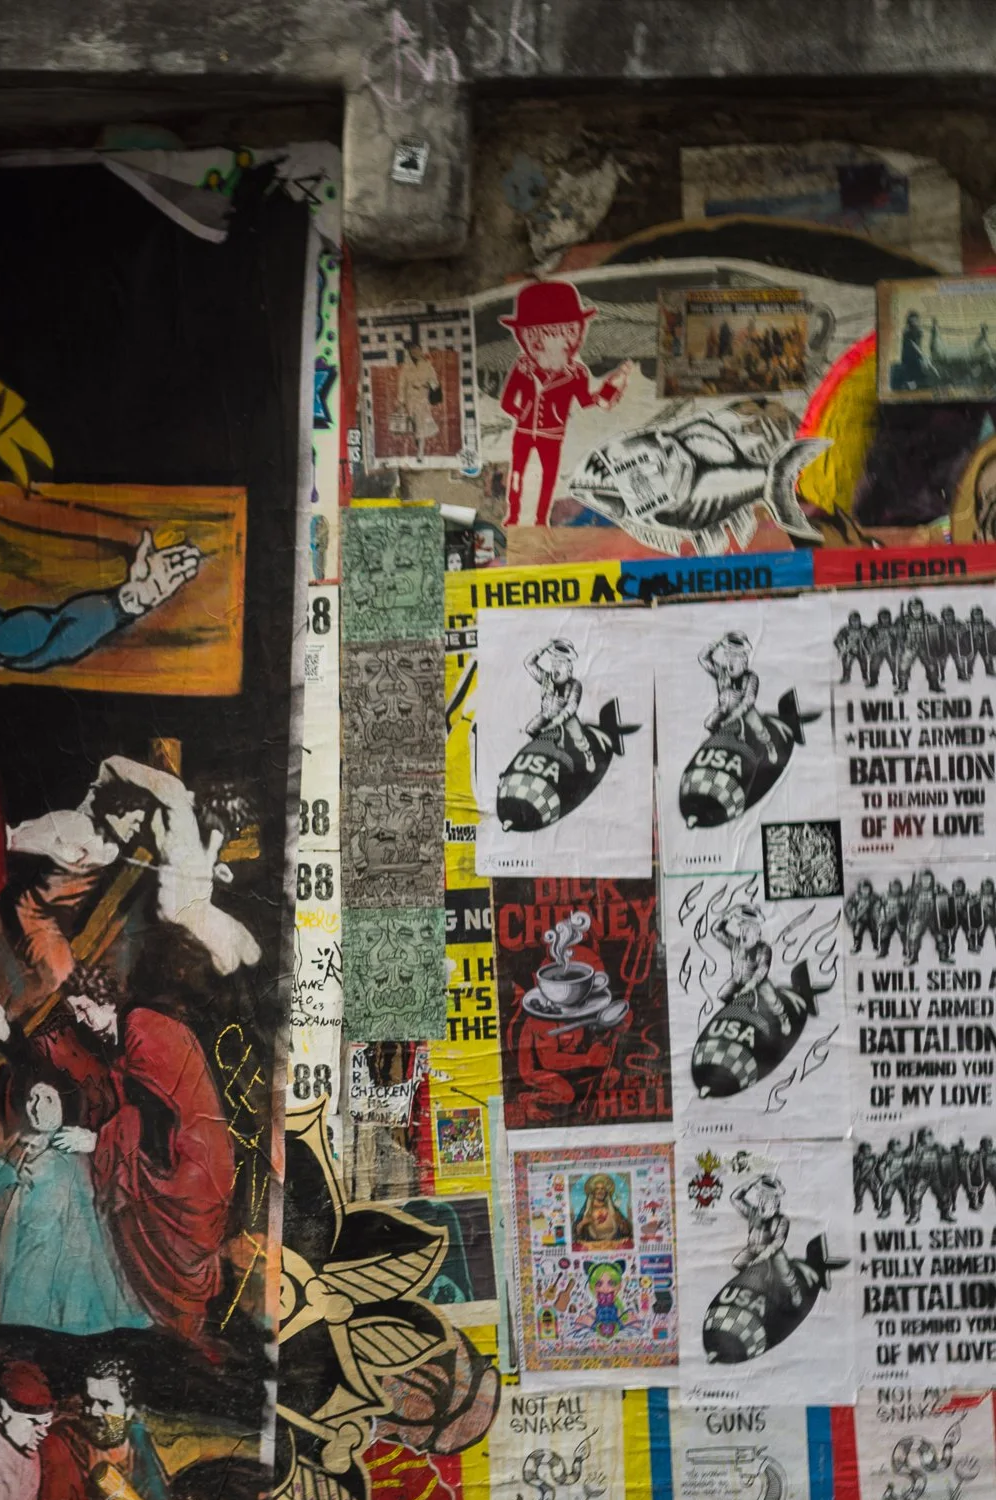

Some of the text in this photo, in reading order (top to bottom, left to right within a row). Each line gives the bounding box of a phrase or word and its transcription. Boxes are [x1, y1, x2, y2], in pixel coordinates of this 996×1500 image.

[470, 577, 580, 608] I HEARD
[847, 696, 995, 723] I WILL SEND A
[858, 725, 985, 749] FULLY ARMED
[513, 752, 561, 784] USA
[694, 747, 743, 779] USA
[849, 752, 996, 785] BATTALION
[862, 787, 986, 809] TO REMIND YOU
[861, 813, 985, 839] OF MY LOVE
[534, 877, 622, 905] DICK
[857, 970, 864, 993] I
[871, 969, 920, 993] WILL
[926, 968, 982, 993] SEND
[868, 996, 994, 1020] FULLY ARMED
[445, 1015, 497, 1041] THE
[706, 1016, 758, 1051] USA
[859, 1024, 996, 1055] BATTALION
[870, 1058, 994, 1079] TO REMIND YOU
[350, 1084, 409, 1099] CHICKEN
[595, 1088, 673, 1117] HELL
[870, 1083, 993, 1108] OF MY LOVE
[860, 1227, 984, 1253] I WILL SEND
[871, 1255, 996, 1280] FULLY ARMED
[716, 1283, 770, 1314] USA
[875, 1315, 996, 1337] TO REMIND YOU
[876, 1340, 996, 1366] OF MY LOVE
[511, 1396, 587, 1416] NOT ALL
[705, 1410, 767, 1436] GUNS
